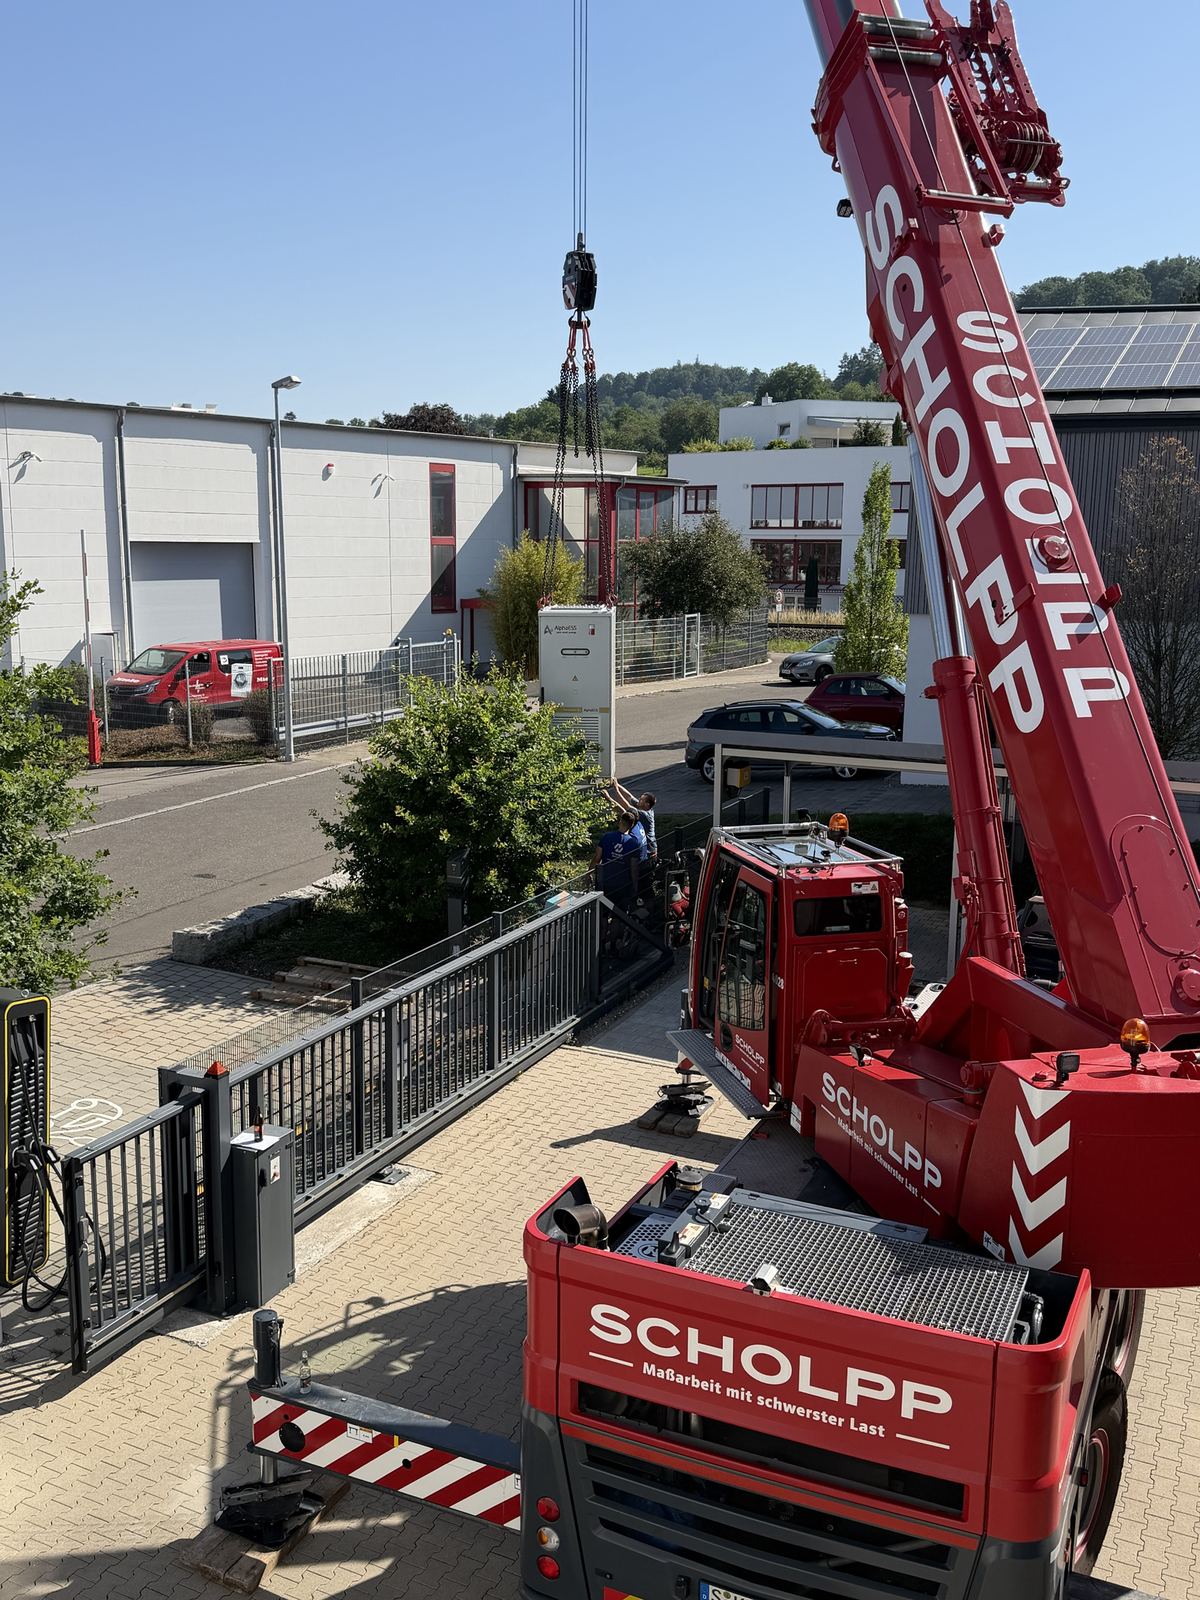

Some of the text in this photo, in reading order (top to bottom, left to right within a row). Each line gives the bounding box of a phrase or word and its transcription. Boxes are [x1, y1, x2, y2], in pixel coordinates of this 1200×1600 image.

[865, 184, 1045, 734] SCHOLPP
[957, 311, 1130, 719] SCHOLPP
[735, 1034, 765, 1065] SCHOLPP
[821, 1072, 942, 1188] SCHOLPP
[837, 1117, 918, 1198] Maßarbeit mit schwerster Last
[589, 1303, 953, 1420] SCHOLPP
[642, 1361, 886, 1438] Maßarbeit mit schwerster Last
